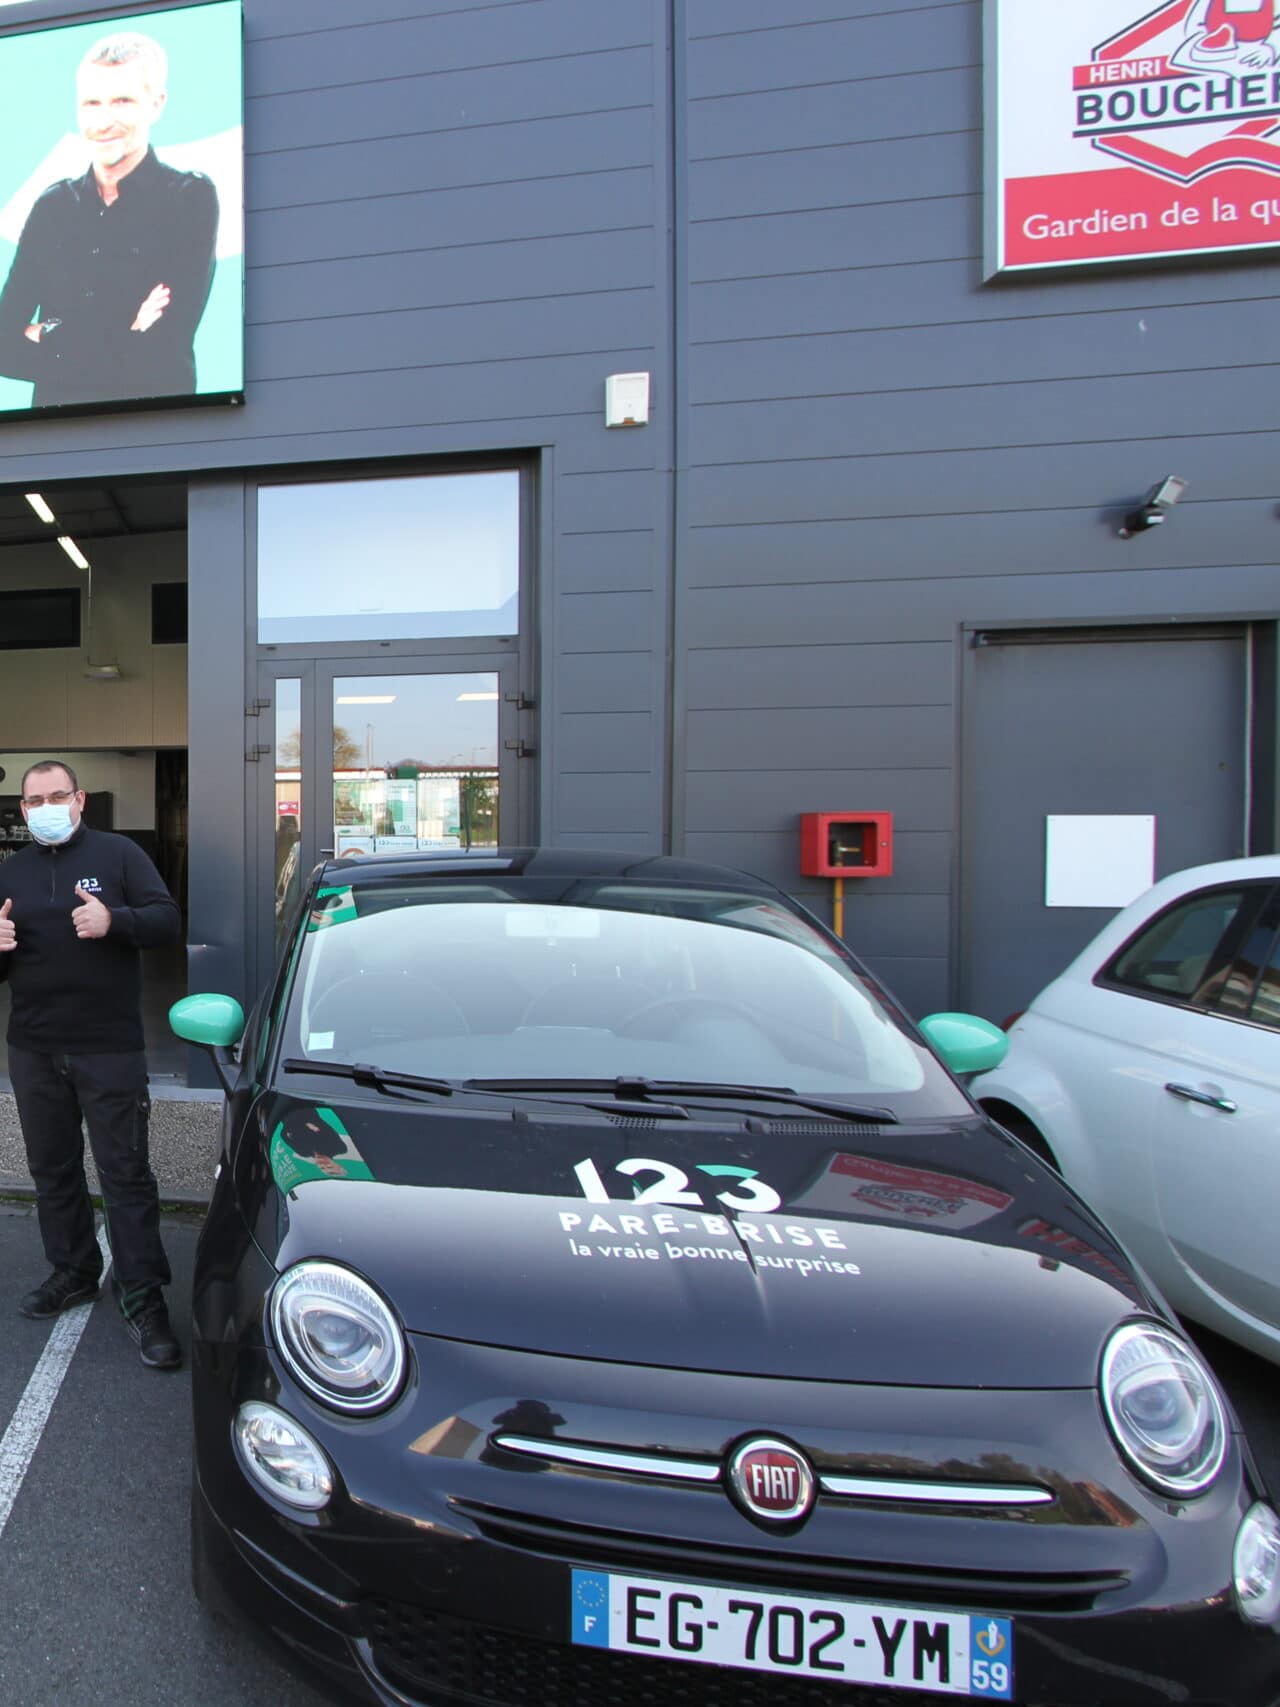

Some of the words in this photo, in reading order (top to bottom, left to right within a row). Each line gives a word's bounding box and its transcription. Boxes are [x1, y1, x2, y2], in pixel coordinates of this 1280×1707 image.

[1089, 58, 1161, 84] HENRI
[1022, 208, 1148, 240] Gardien
[1160, 201, 1200, 227] de
[1212, 197, 1238, 222] la
[574, 1157, 781, 1213] 123
[558, 1212, 848, 1250] PARE-BRISE
[569, 1239, 592, 1257] la
[598, 1242, 660, 1260] vraie
[664, 1242, 748, 1262] bonne
[754, 1255, 861, 1276] surprise
[751, 1463, 796, 1500] FIAT
[583, 1616, 597, 1633] F
[626, 1586, 950, 1684] EG-702-YM
[971, 1661, 1008, 1692] 59
